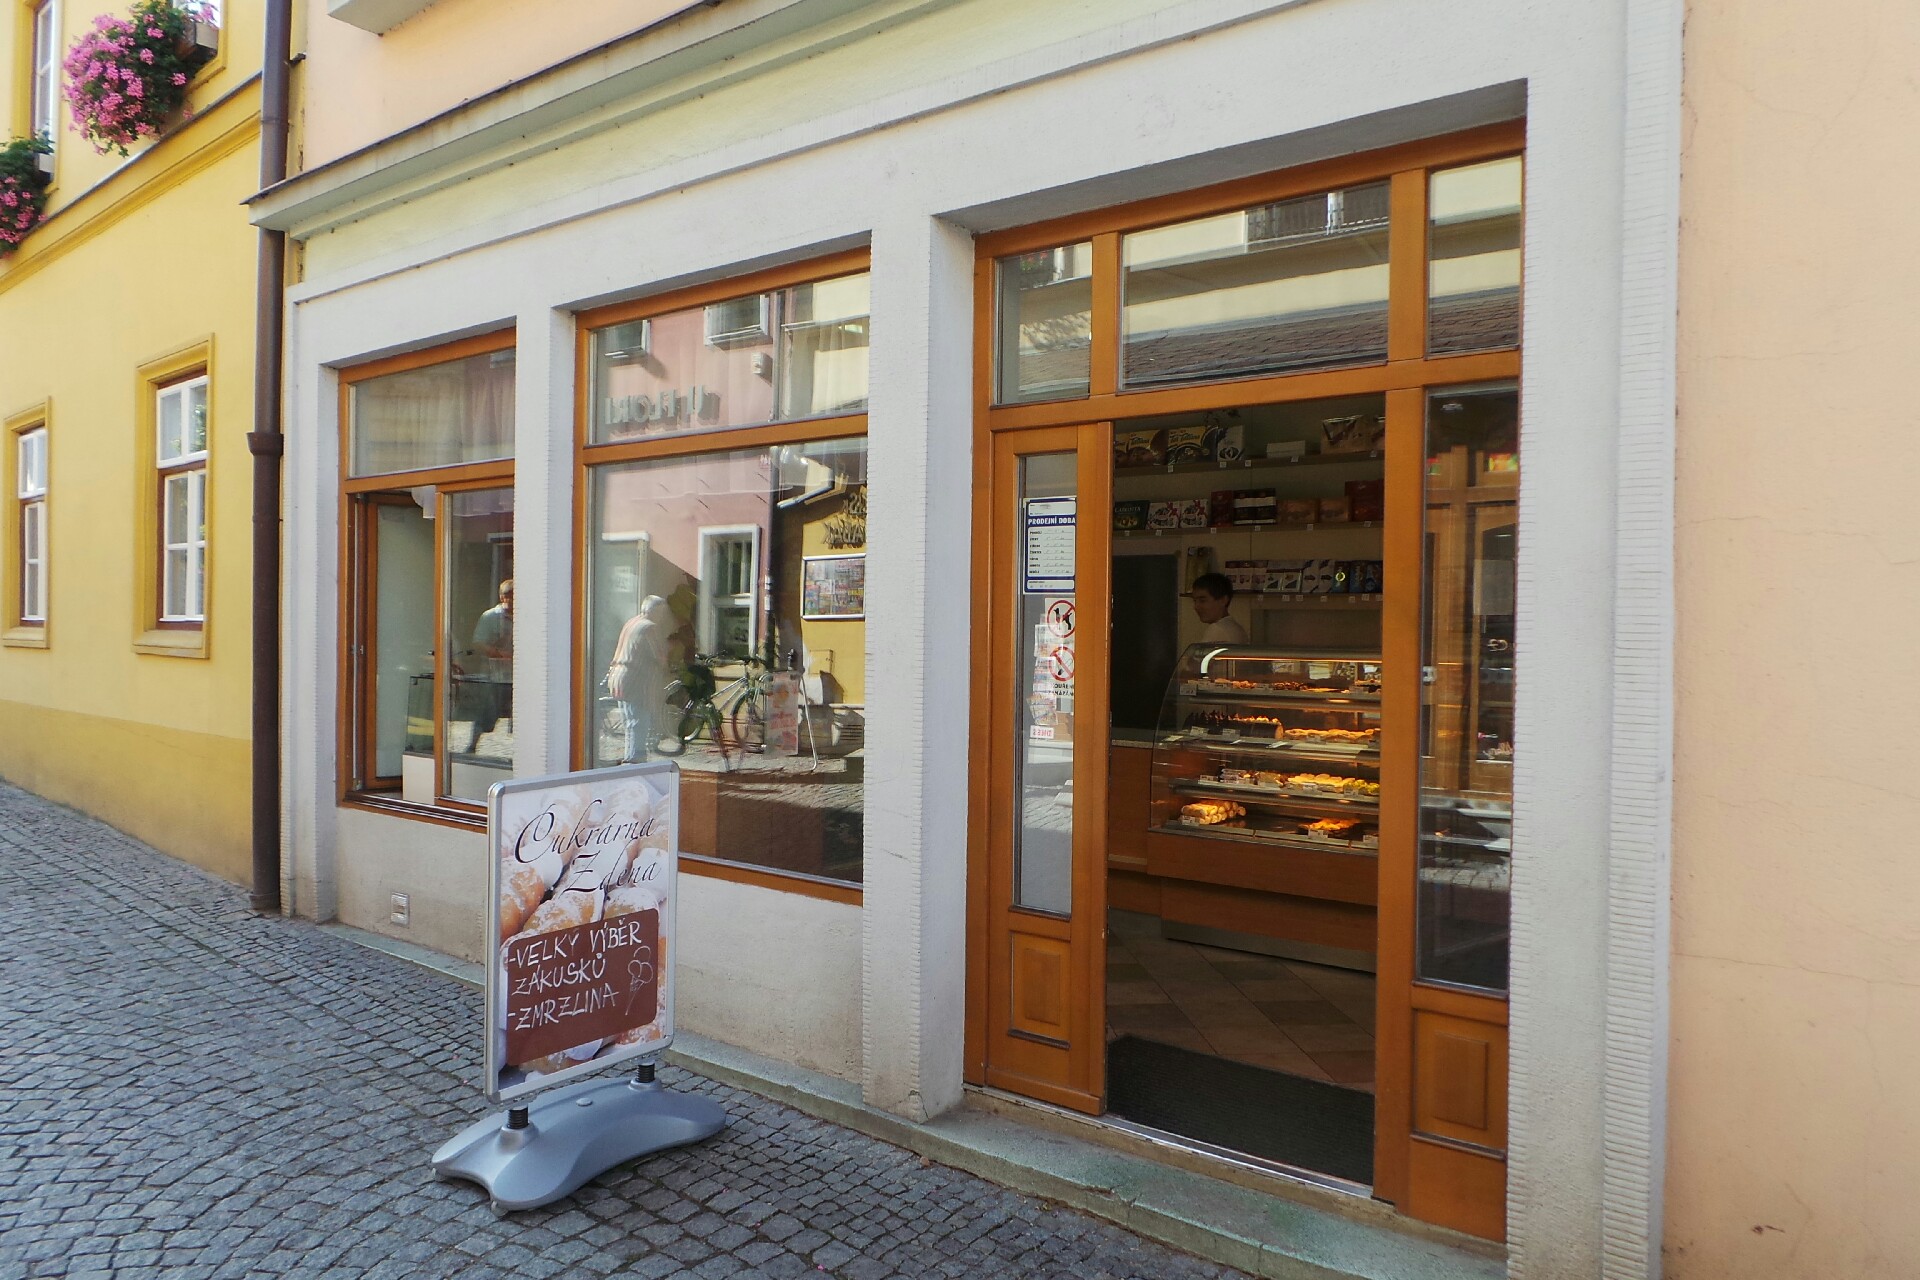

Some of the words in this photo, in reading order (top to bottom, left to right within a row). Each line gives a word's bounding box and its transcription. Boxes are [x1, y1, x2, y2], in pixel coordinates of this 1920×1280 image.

[1028, 516, 1057, 525] PRODEJNÍ
[514, 799, 657, 864] Cukrárna
[558, 838, 661, 899] Zdena
[589, 917, 643, 953] VÝBĚR
[511, 952, 607, 996] ZÁKUSKŮ
